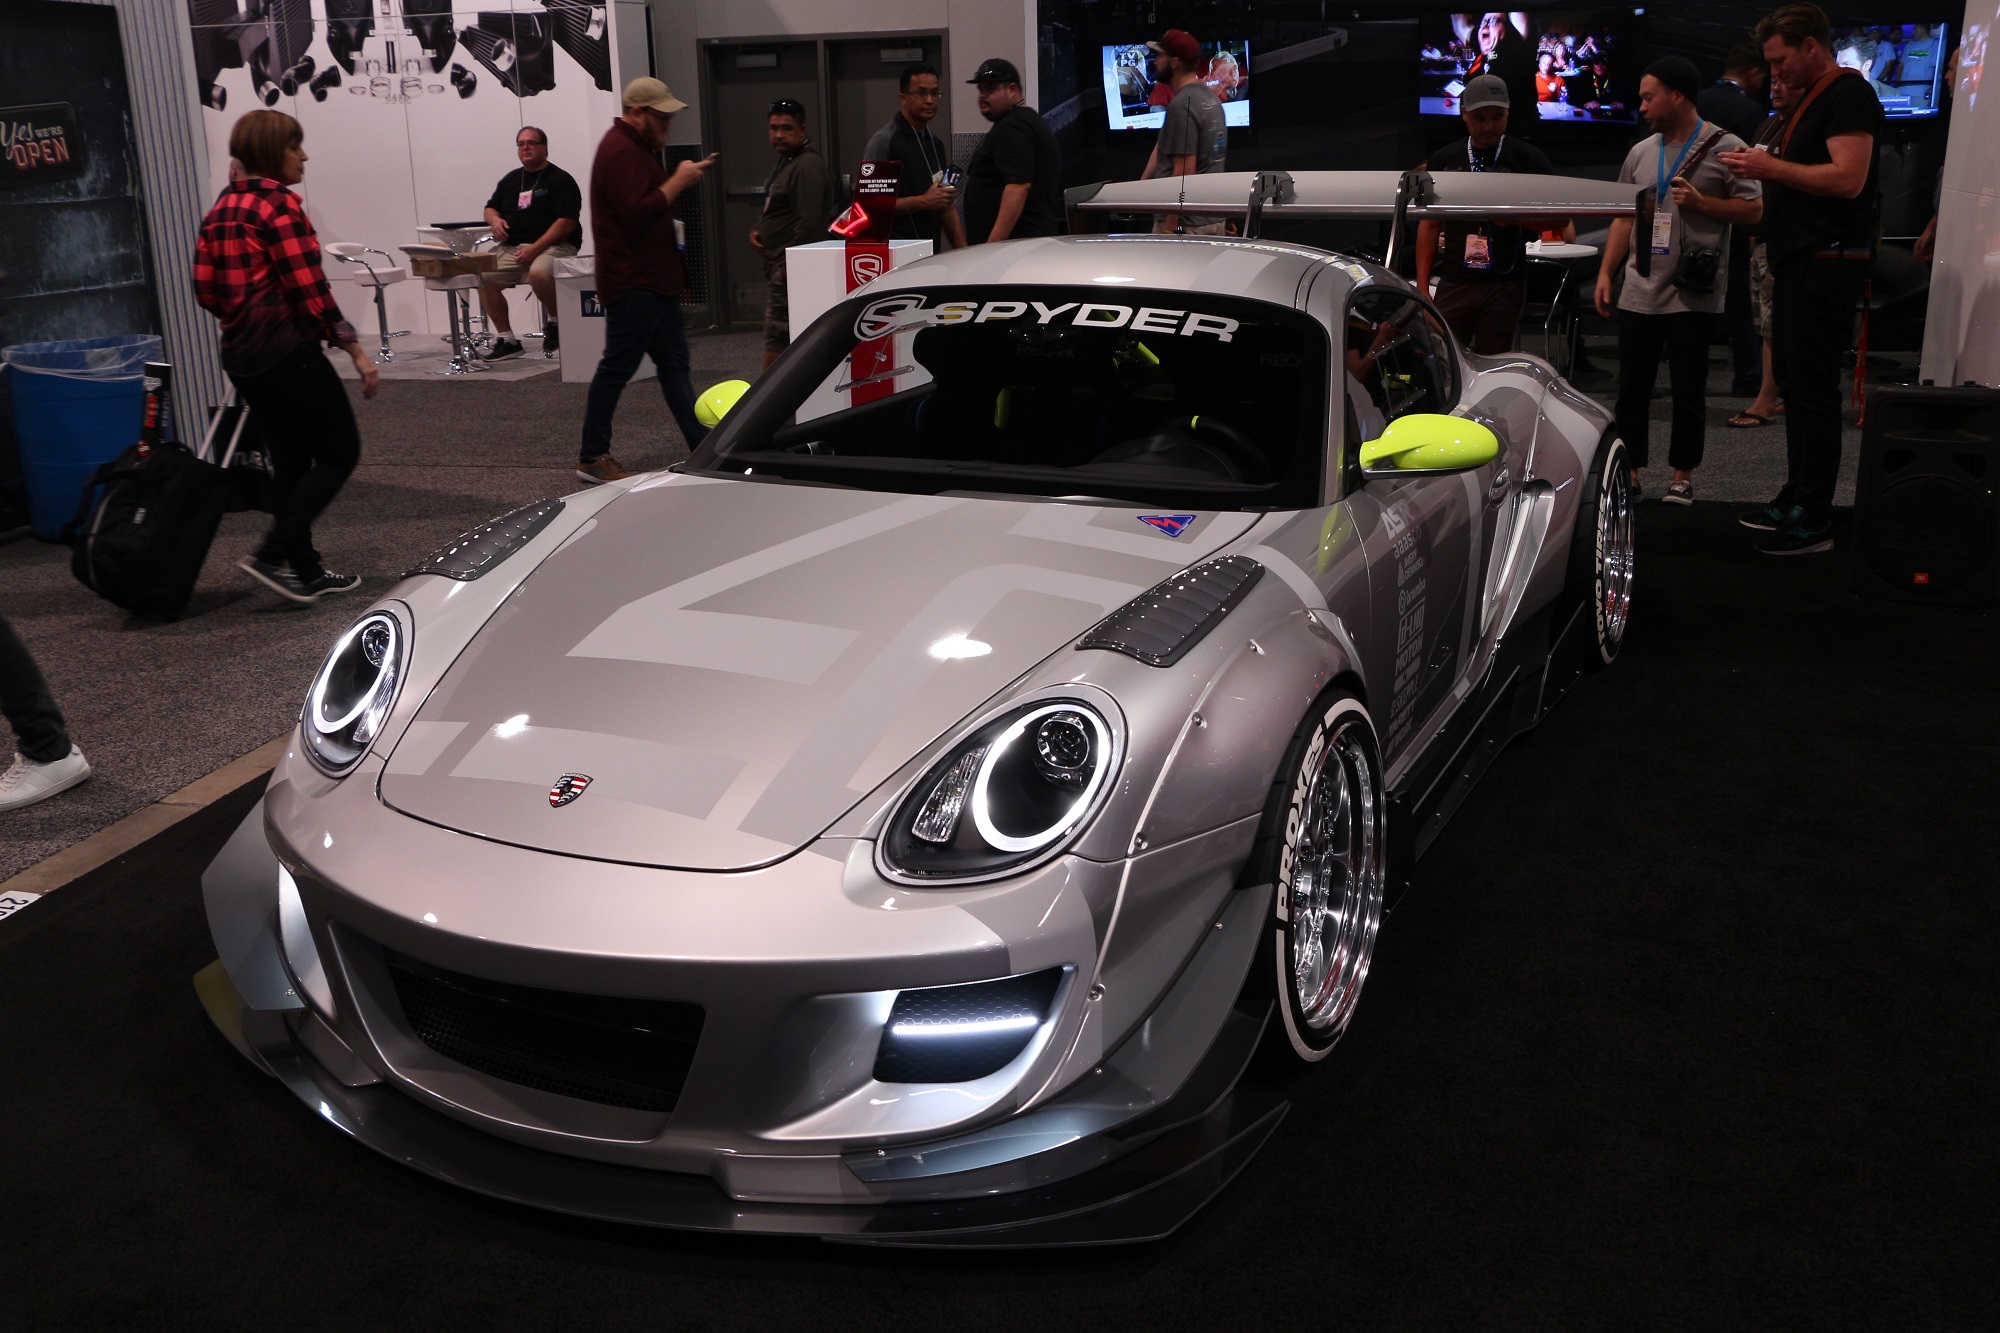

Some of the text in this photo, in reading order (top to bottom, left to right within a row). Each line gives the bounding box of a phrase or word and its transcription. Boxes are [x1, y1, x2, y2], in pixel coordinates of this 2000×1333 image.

[1119, 52, 1136, 60] TV
[1120, 59, 1136, 67] PG
[0, 121, 64, 161] Yes WE'RE
[13, 136, 70, 171] OPEN
[930, 301, 1240, 343] SPYDER
[1276, 723, 1325, 923] PROXES
